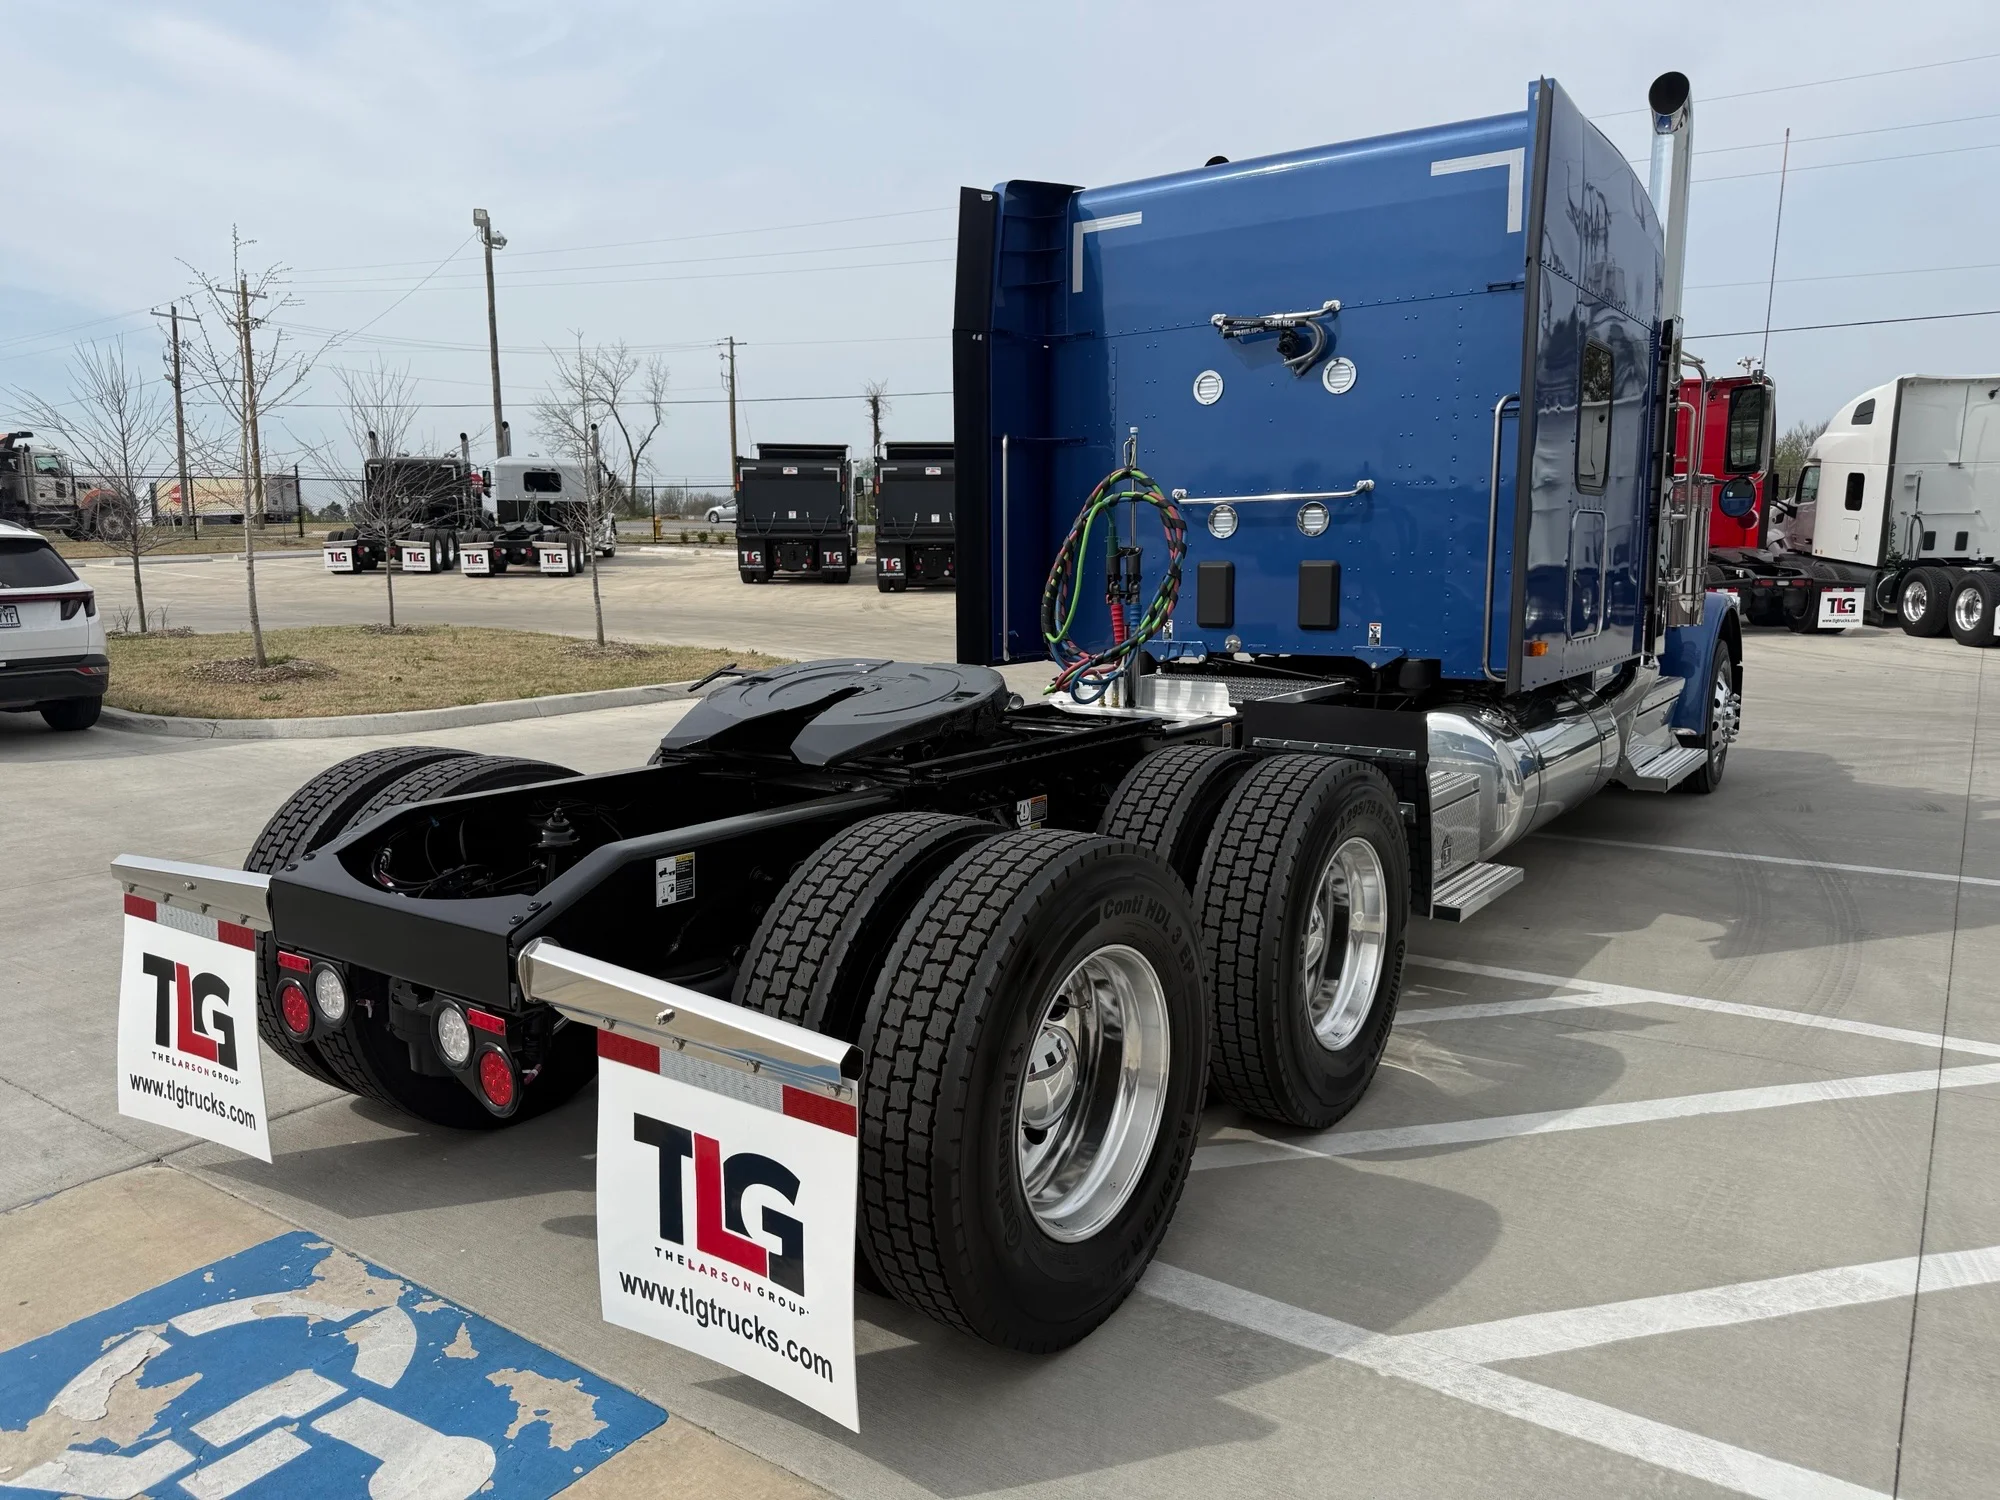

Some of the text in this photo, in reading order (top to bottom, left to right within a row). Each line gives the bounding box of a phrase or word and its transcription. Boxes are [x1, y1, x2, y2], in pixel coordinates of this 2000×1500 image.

[328, 552, 347, 563] TLG
[406, 552, 425, 563] TLG
[465, 554, 484, 565] TLG
[544, 553, 563, 564] TLG
[741, 551, 761, 564] TLG
[823, 551, 843, 564] TLG
[880, 557, 902, 571] TLG
[1827, 598, 1856, 614] TLG
[1103, 894, 1145, 920] Conti
[1144, 897, 1172, 933] HDL
[1171, 926, 1183, 945] 3
[1178, 941, 1195, 973] EP
[143, 952, 238, 1072] TLG
[211, 1070, 241, 1086] GROUP
[130, 1073, 256, 1131] www.tlgtrucks.com
[633, 1112, 805, 1297] TLG
[757, 1287, 808, 1317] GROUP
[619, 1271, 834, 1383] www.tlgtrucks.com
